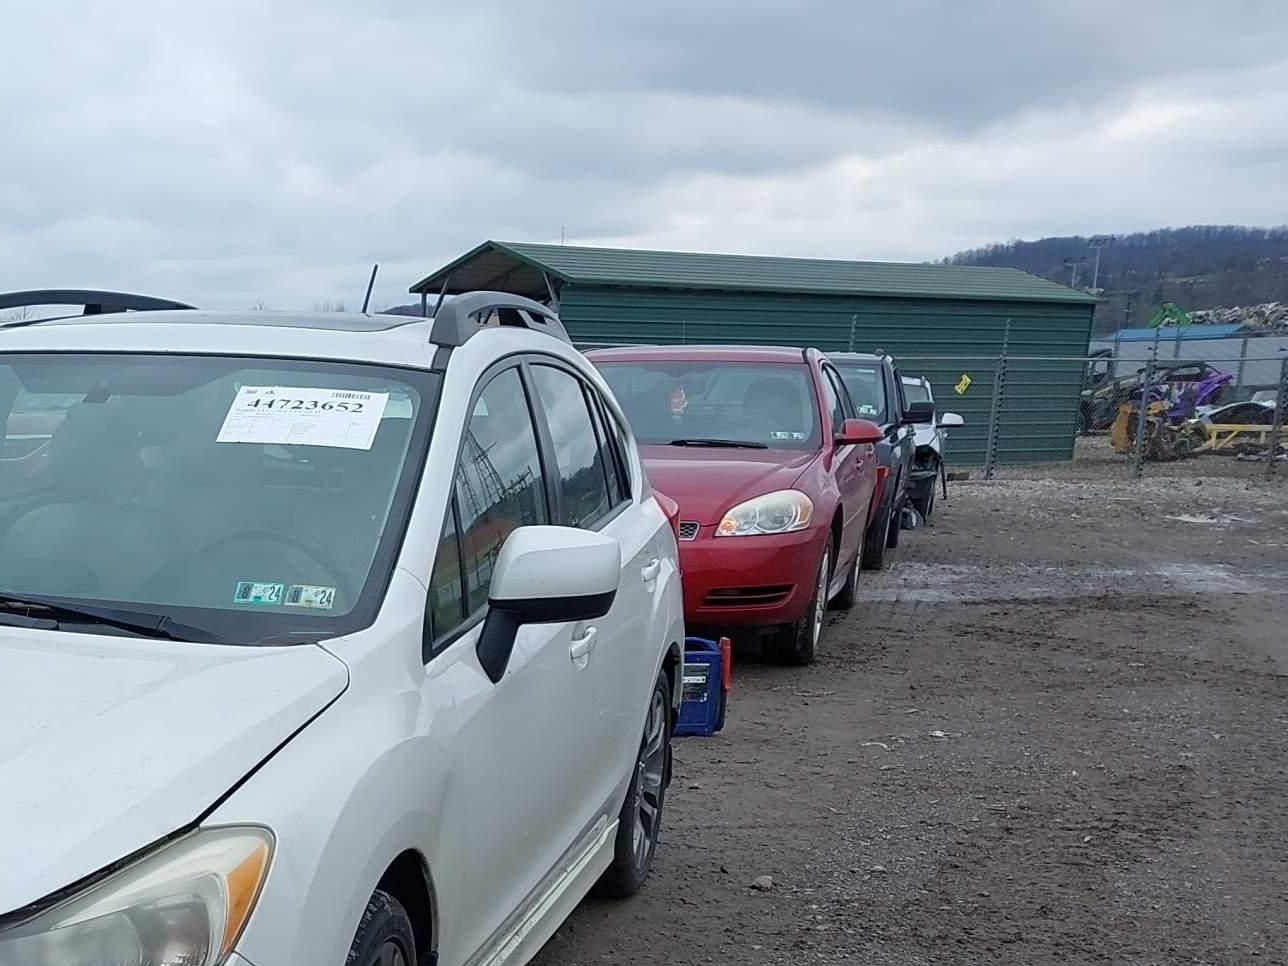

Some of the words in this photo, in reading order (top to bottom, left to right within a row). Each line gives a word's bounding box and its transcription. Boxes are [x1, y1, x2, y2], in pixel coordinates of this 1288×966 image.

[247, 398, 364, 414] 44723652
[268, 585, 282, 601] 24
[319, 590, 333, 605] 24
